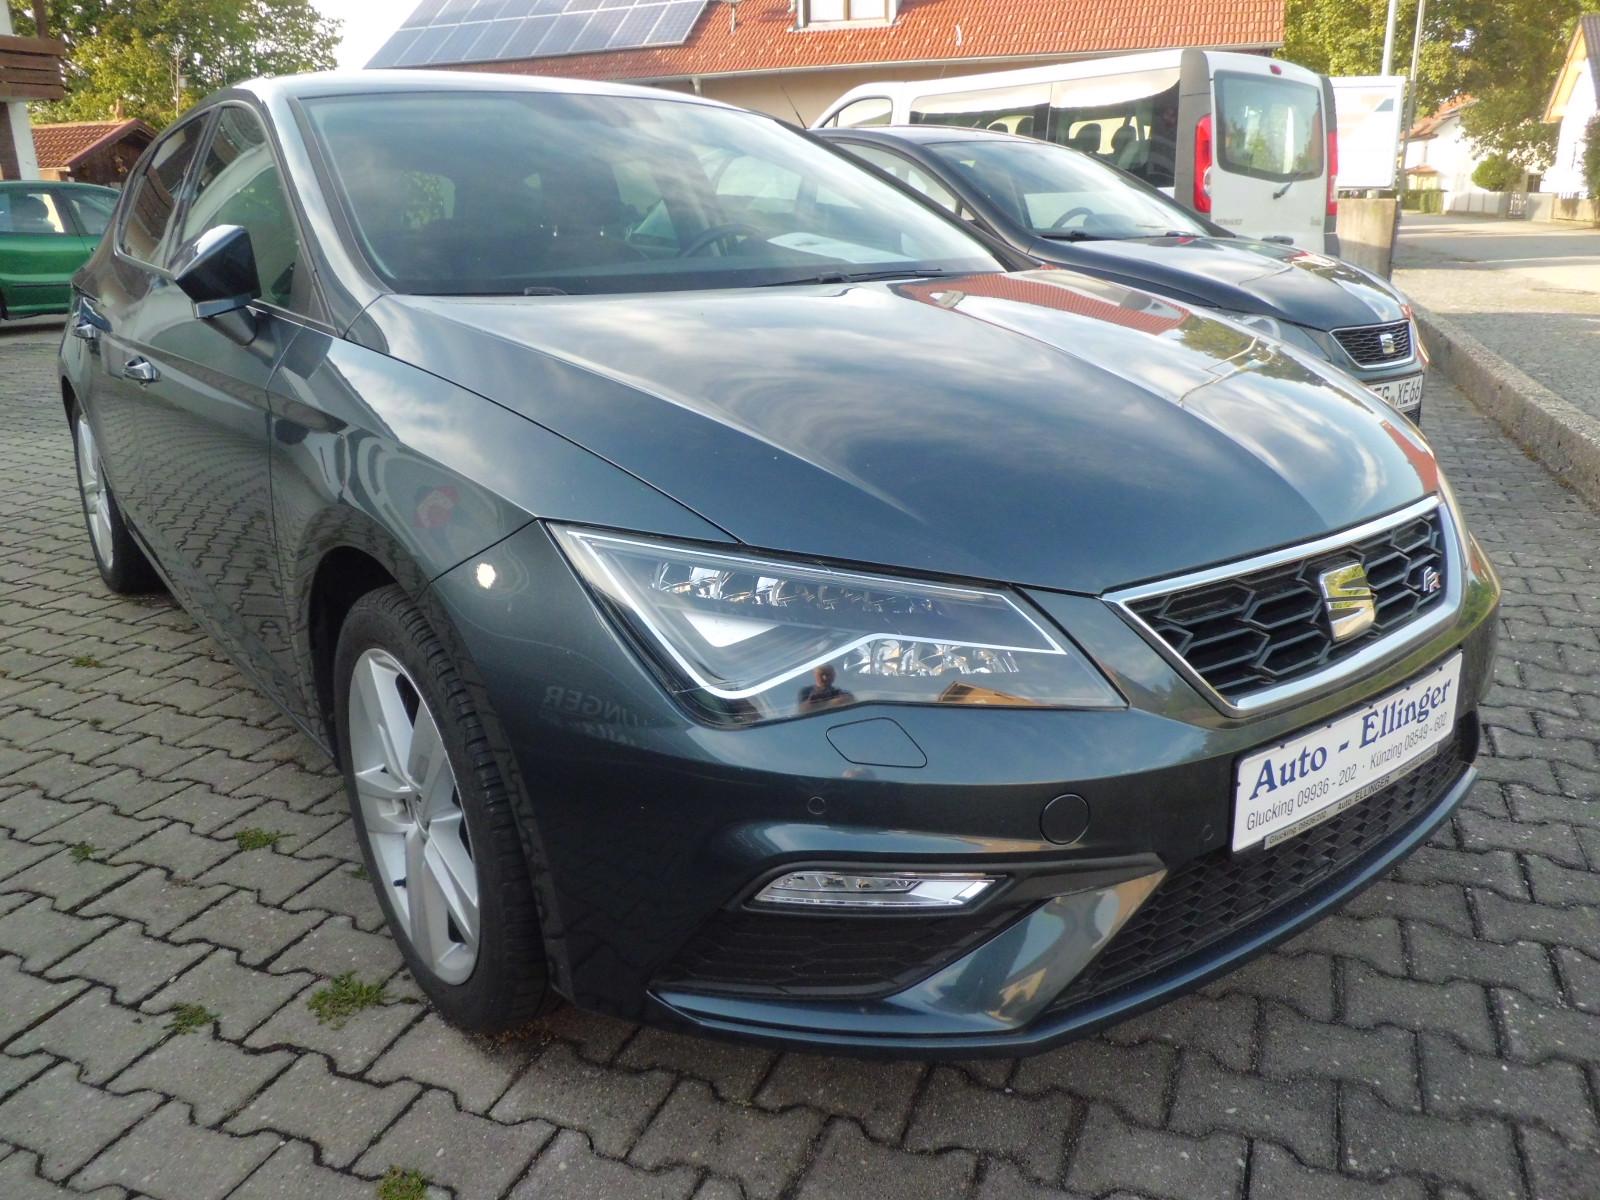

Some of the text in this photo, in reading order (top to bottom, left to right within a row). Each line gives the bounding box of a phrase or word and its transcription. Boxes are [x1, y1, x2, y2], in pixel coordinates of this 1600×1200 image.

[1249, 746, 1328, 801] Auto
[1359, 679, 1452, 749] Ellinger
[1247, 798, 1294, 831] Glucking
[1297, 777, 1330, 808] 09936
[1338, 763, 1357, 787] 202
[1370, 742, 1403, 770] Künzing
[1337, 799, 1352, 812] Auto
[1355, 775, 1391, 802] ELLINGER
